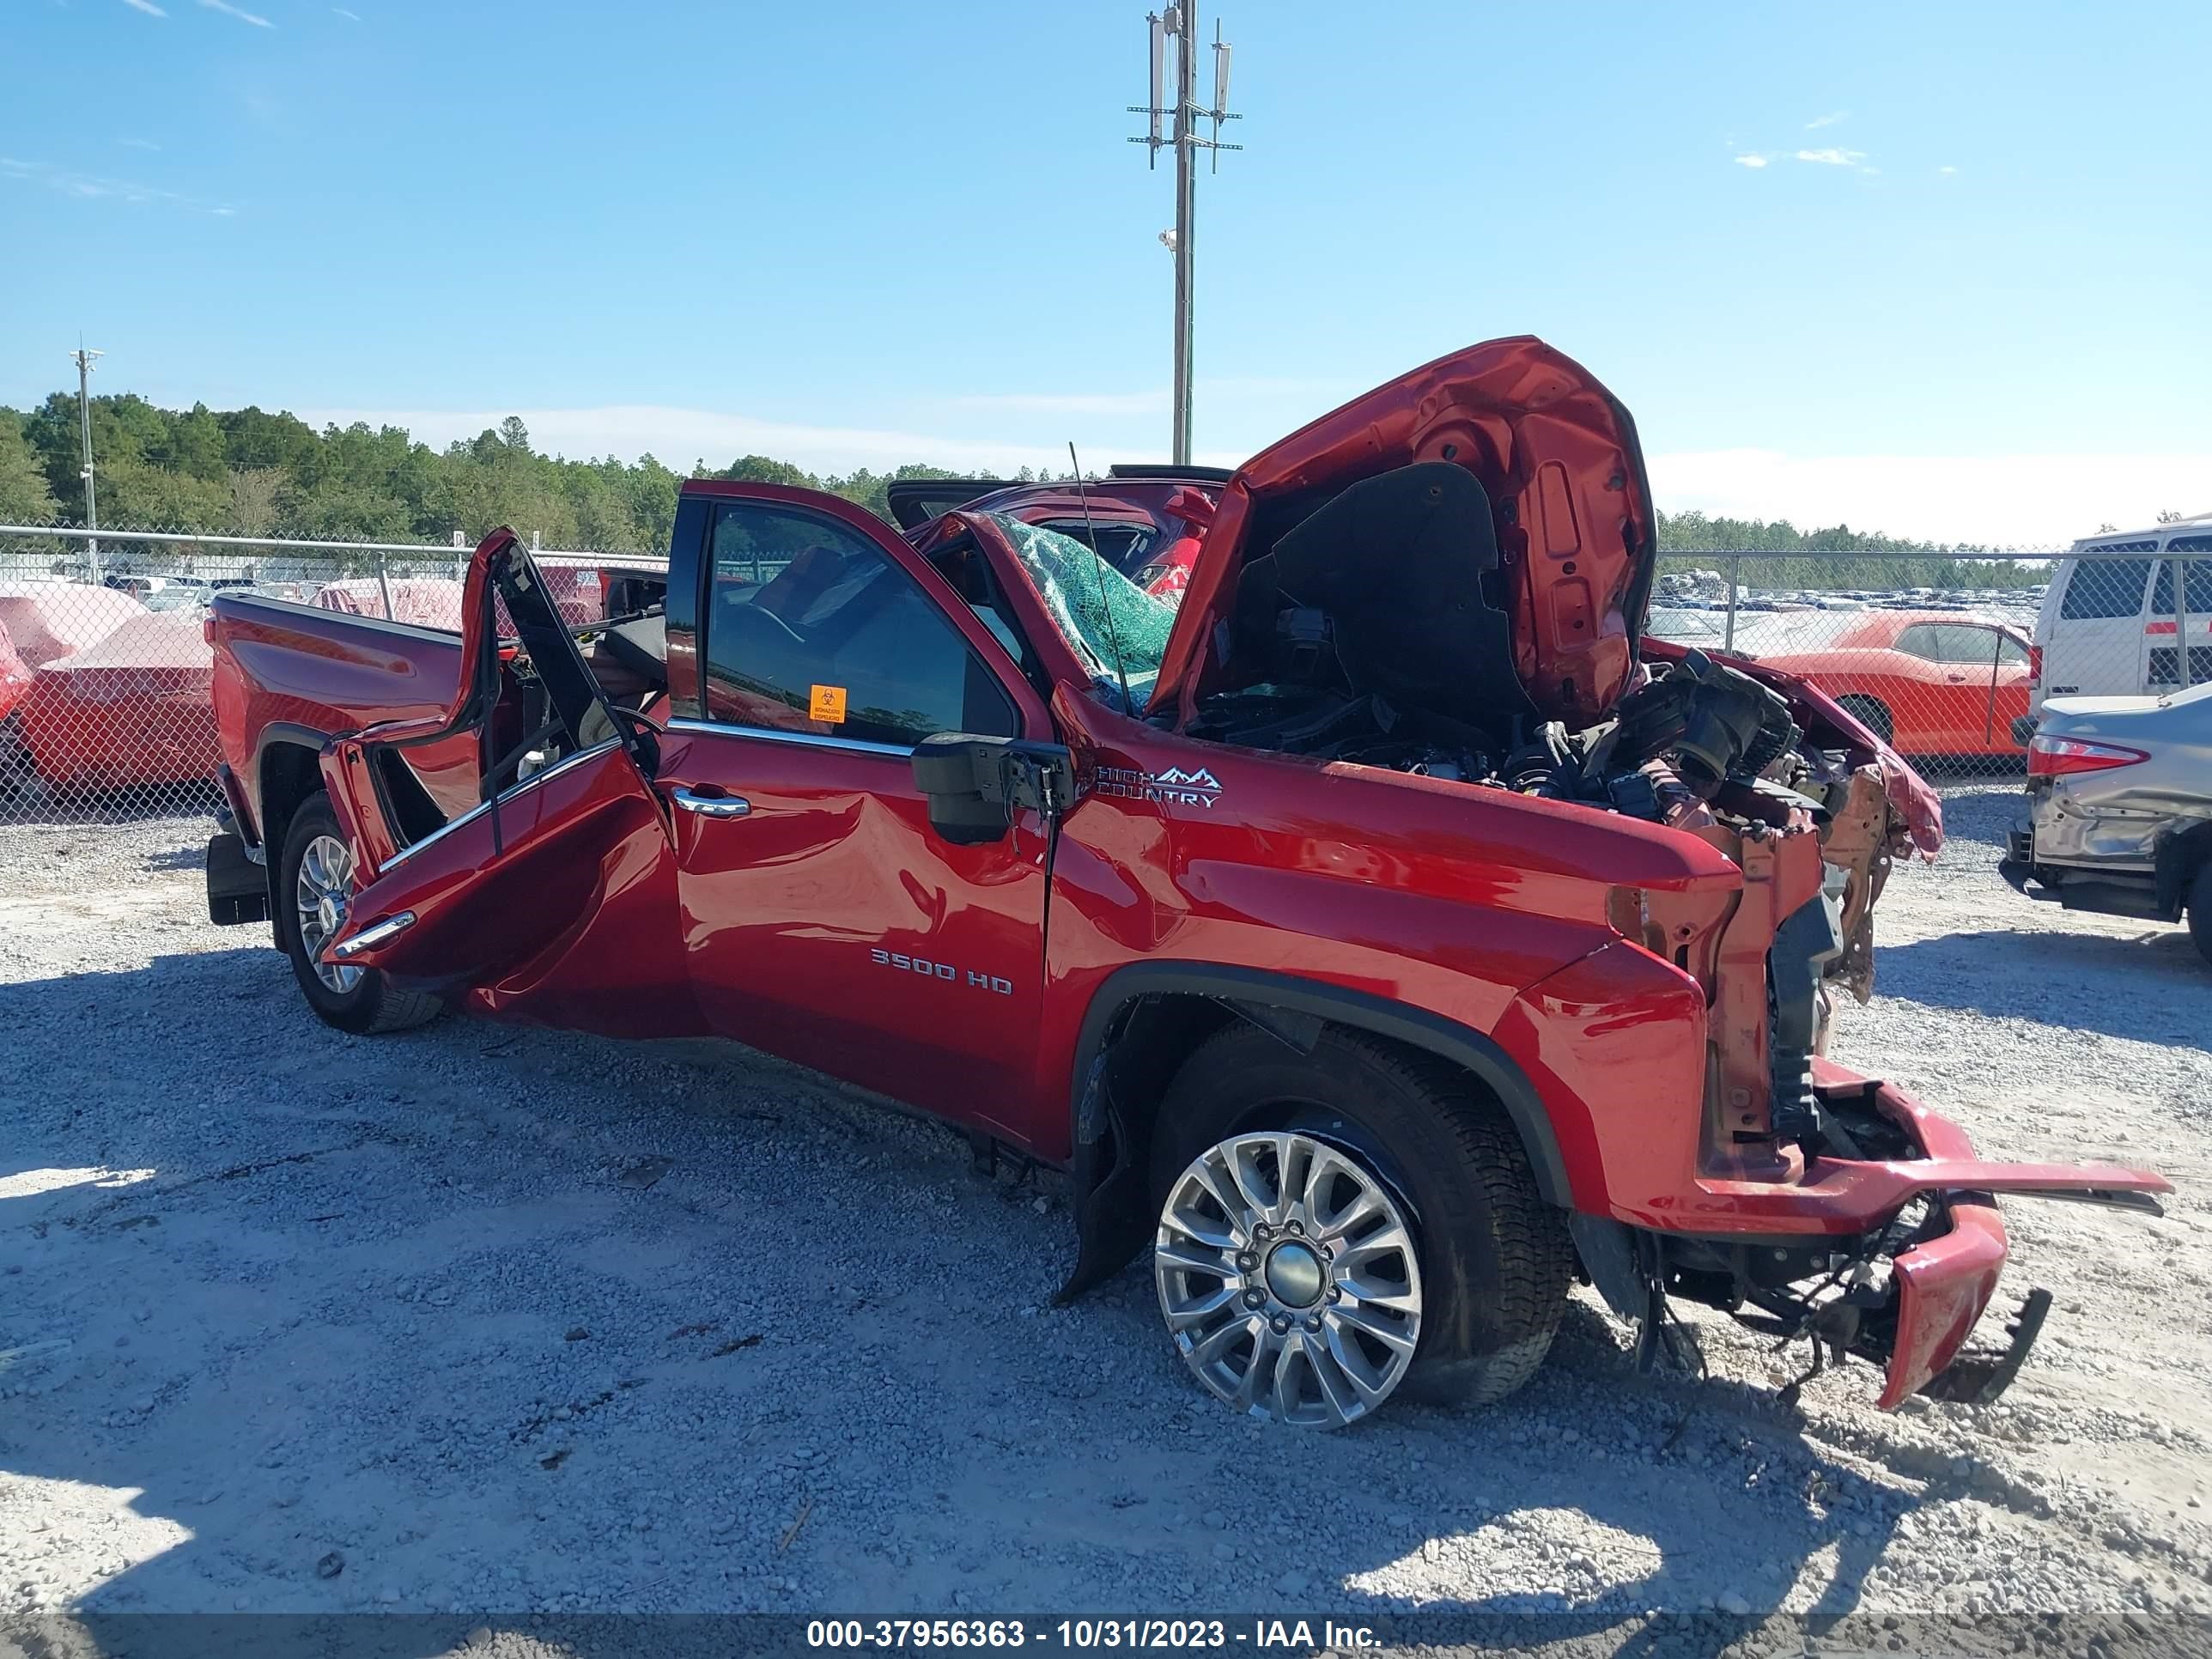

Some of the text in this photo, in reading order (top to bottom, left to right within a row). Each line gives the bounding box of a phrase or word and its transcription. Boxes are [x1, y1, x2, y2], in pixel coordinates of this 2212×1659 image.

[1097, 766, 1155, 785] HIGH
[1097, 781, 1221, 808] COUNTRY
[871, 948, 1012, 995] 3500 HD
